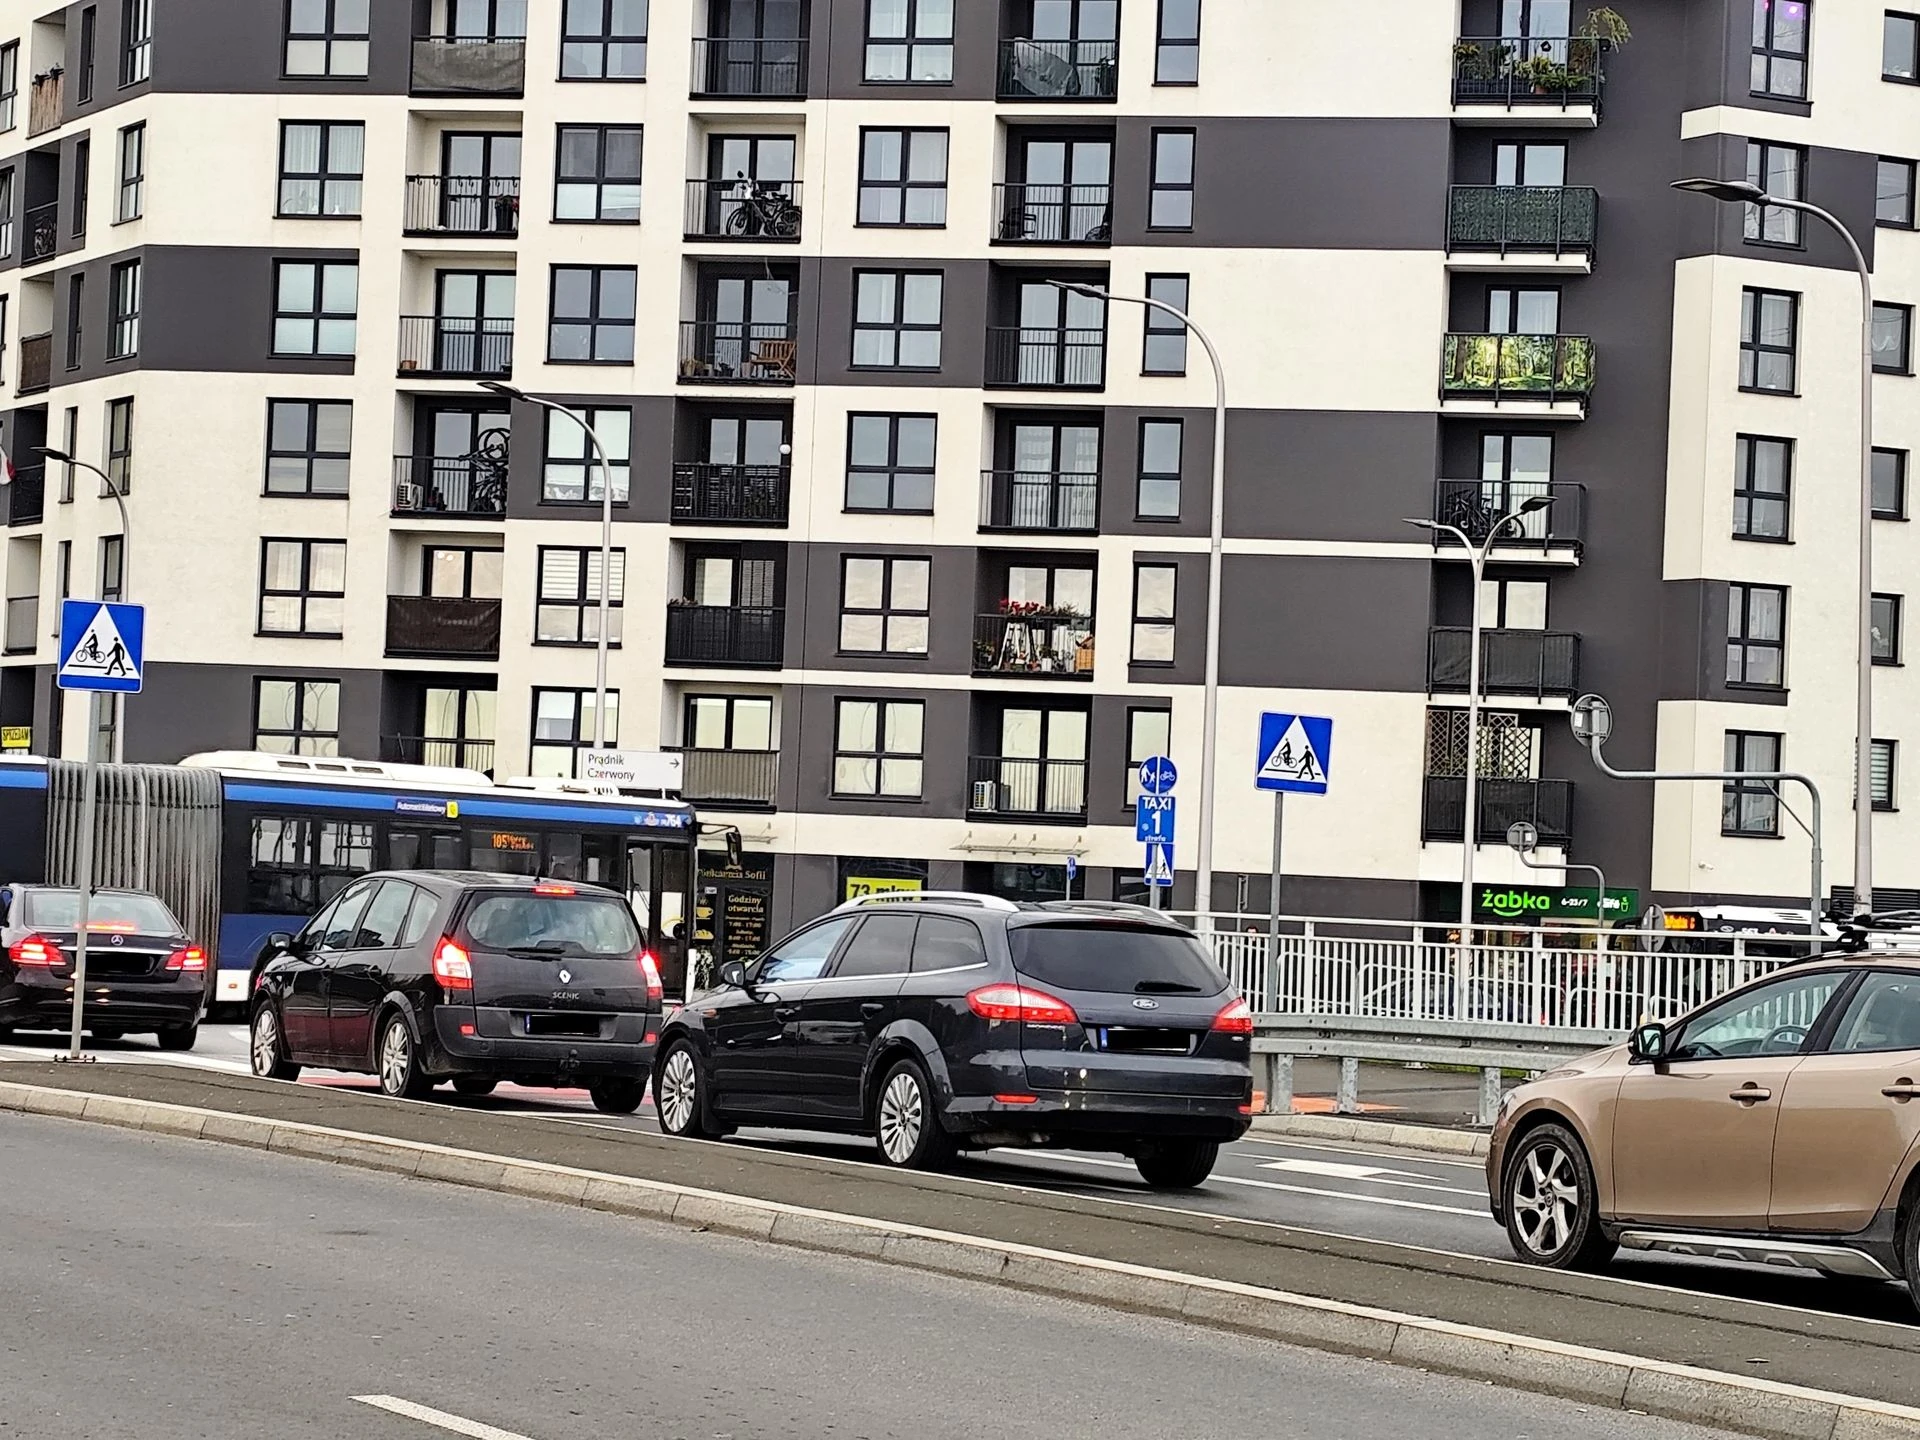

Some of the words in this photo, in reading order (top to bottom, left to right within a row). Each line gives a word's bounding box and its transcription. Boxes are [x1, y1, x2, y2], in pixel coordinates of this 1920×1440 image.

[588, 754, 625, 767] Prądnik
[587, 768, 635, 782] Czerwony
[1142, 797, 1171, 811] TAXI
[1151, 810, 1161, 835] 1
[493, 833, 508, 849] 105
[850, 883, 871, 899] 73
[728, 894, 761, 905] Godziny
[1481, 889, 1550, 909] żabka
[552, 991, 580, 1000] SCENIC
